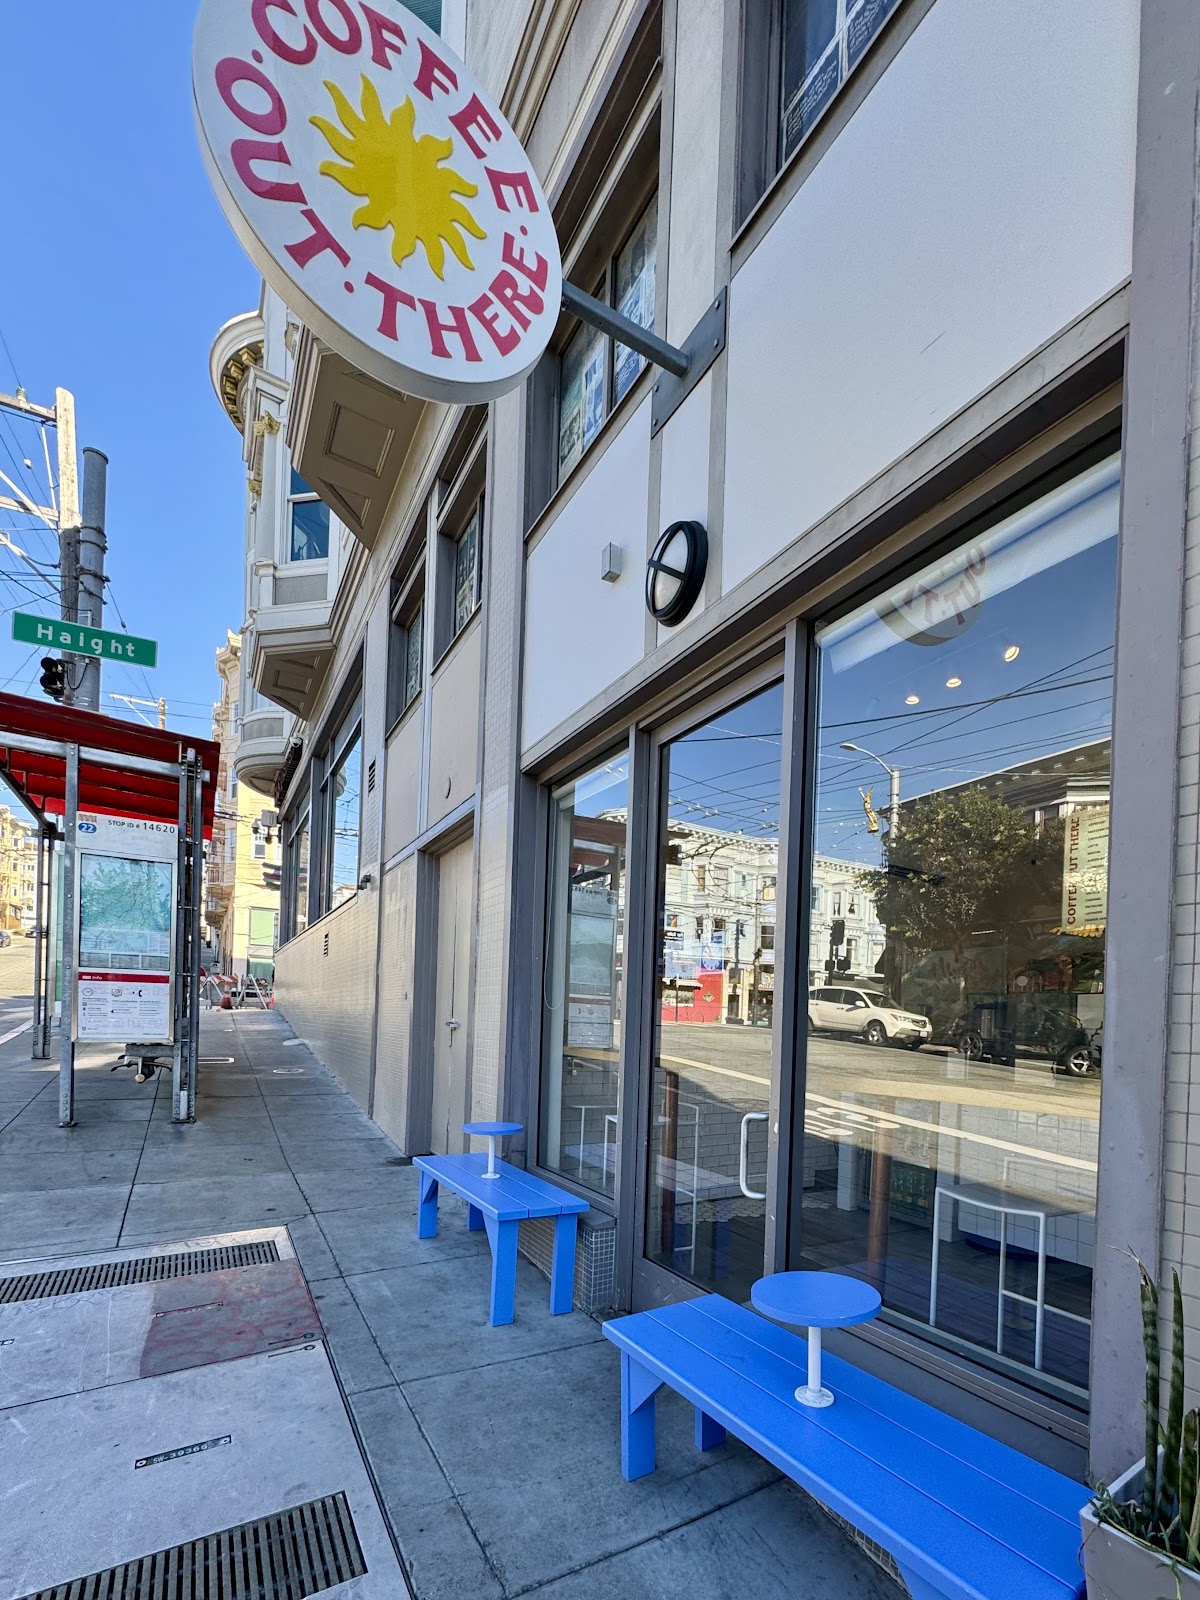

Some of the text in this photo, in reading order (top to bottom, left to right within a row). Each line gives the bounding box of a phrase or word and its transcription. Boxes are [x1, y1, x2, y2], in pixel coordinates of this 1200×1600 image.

[215, 0, 548, 362] COFFEE OUT THERE
[37, 624, 135, 657] Haight
[81, 824, 94, 833] 22
[143, 822, 175, 834] 14620
[1070, 817, 1080, 852] THERE
[1070, 856, 1078, 874] UT
